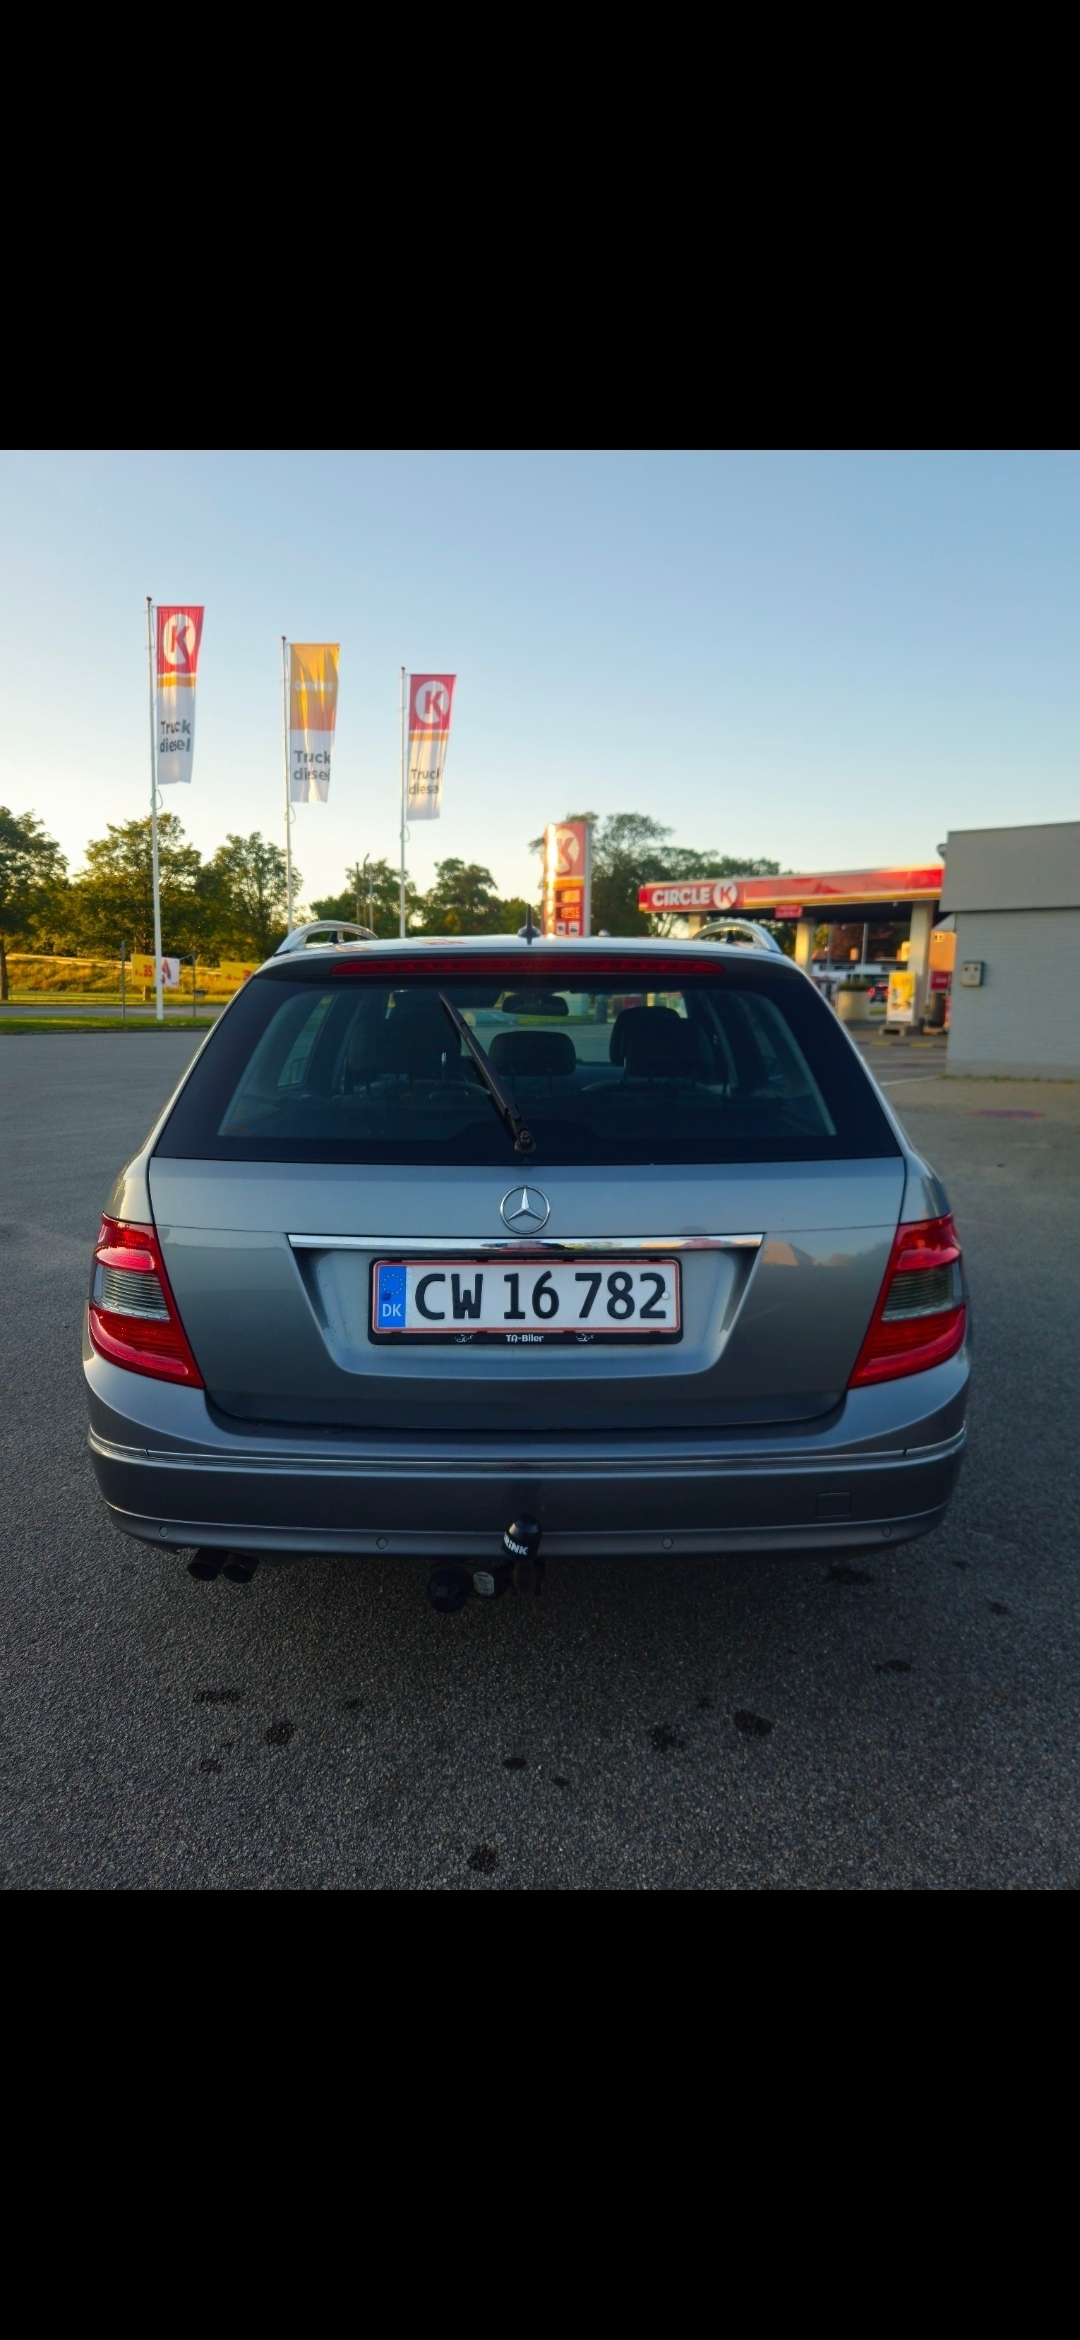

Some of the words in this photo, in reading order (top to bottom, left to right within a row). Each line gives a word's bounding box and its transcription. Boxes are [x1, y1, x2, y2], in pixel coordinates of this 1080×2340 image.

[160, 719, 191, 735] Truck
[160, 738, 191, 753] diesel
[294, 750, 331, 764] Truck
[409, 783, 439, 795] diese
[652, 887, 711, 907] CIRCLE
[719, 886, 734, 906] K
[415, 1273, 484, 1320] CW
[503, 1271, 560, 1320] 16
[575, 1271, 667, 1320] 782
[382, 1303, 402, 1317] DK
